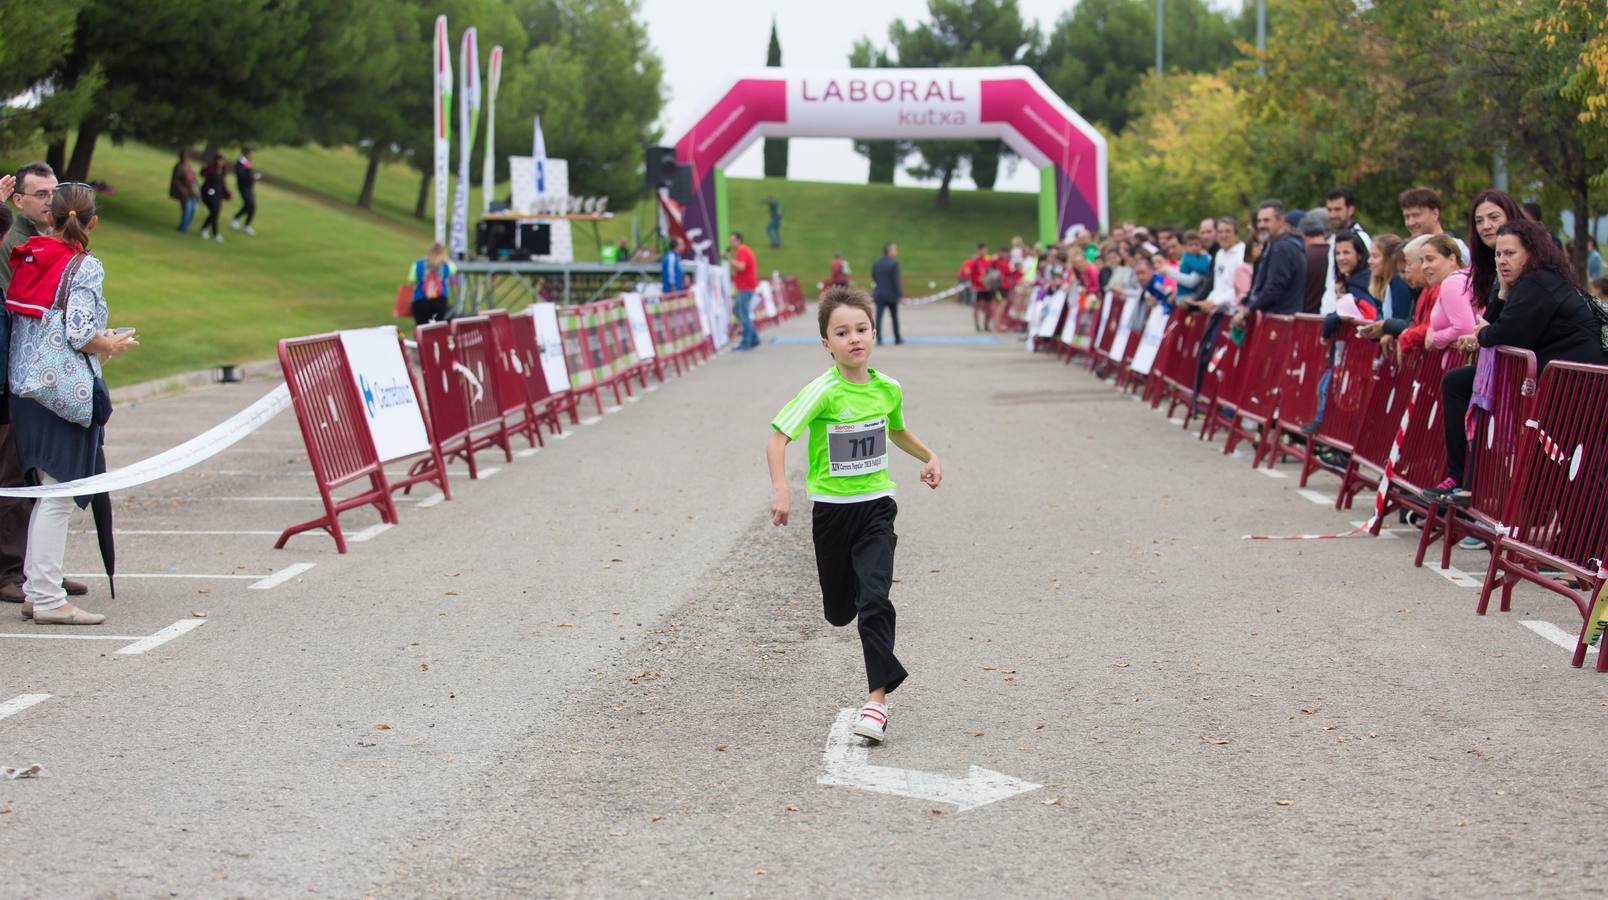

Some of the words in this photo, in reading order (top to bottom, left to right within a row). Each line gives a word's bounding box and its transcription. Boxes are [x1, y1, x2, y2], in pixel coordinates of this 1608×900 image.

[802, 79, 966, 102] LABORAL
[899, 108, 967, 126] kutxa
[848, 436, 875, 458] 717
